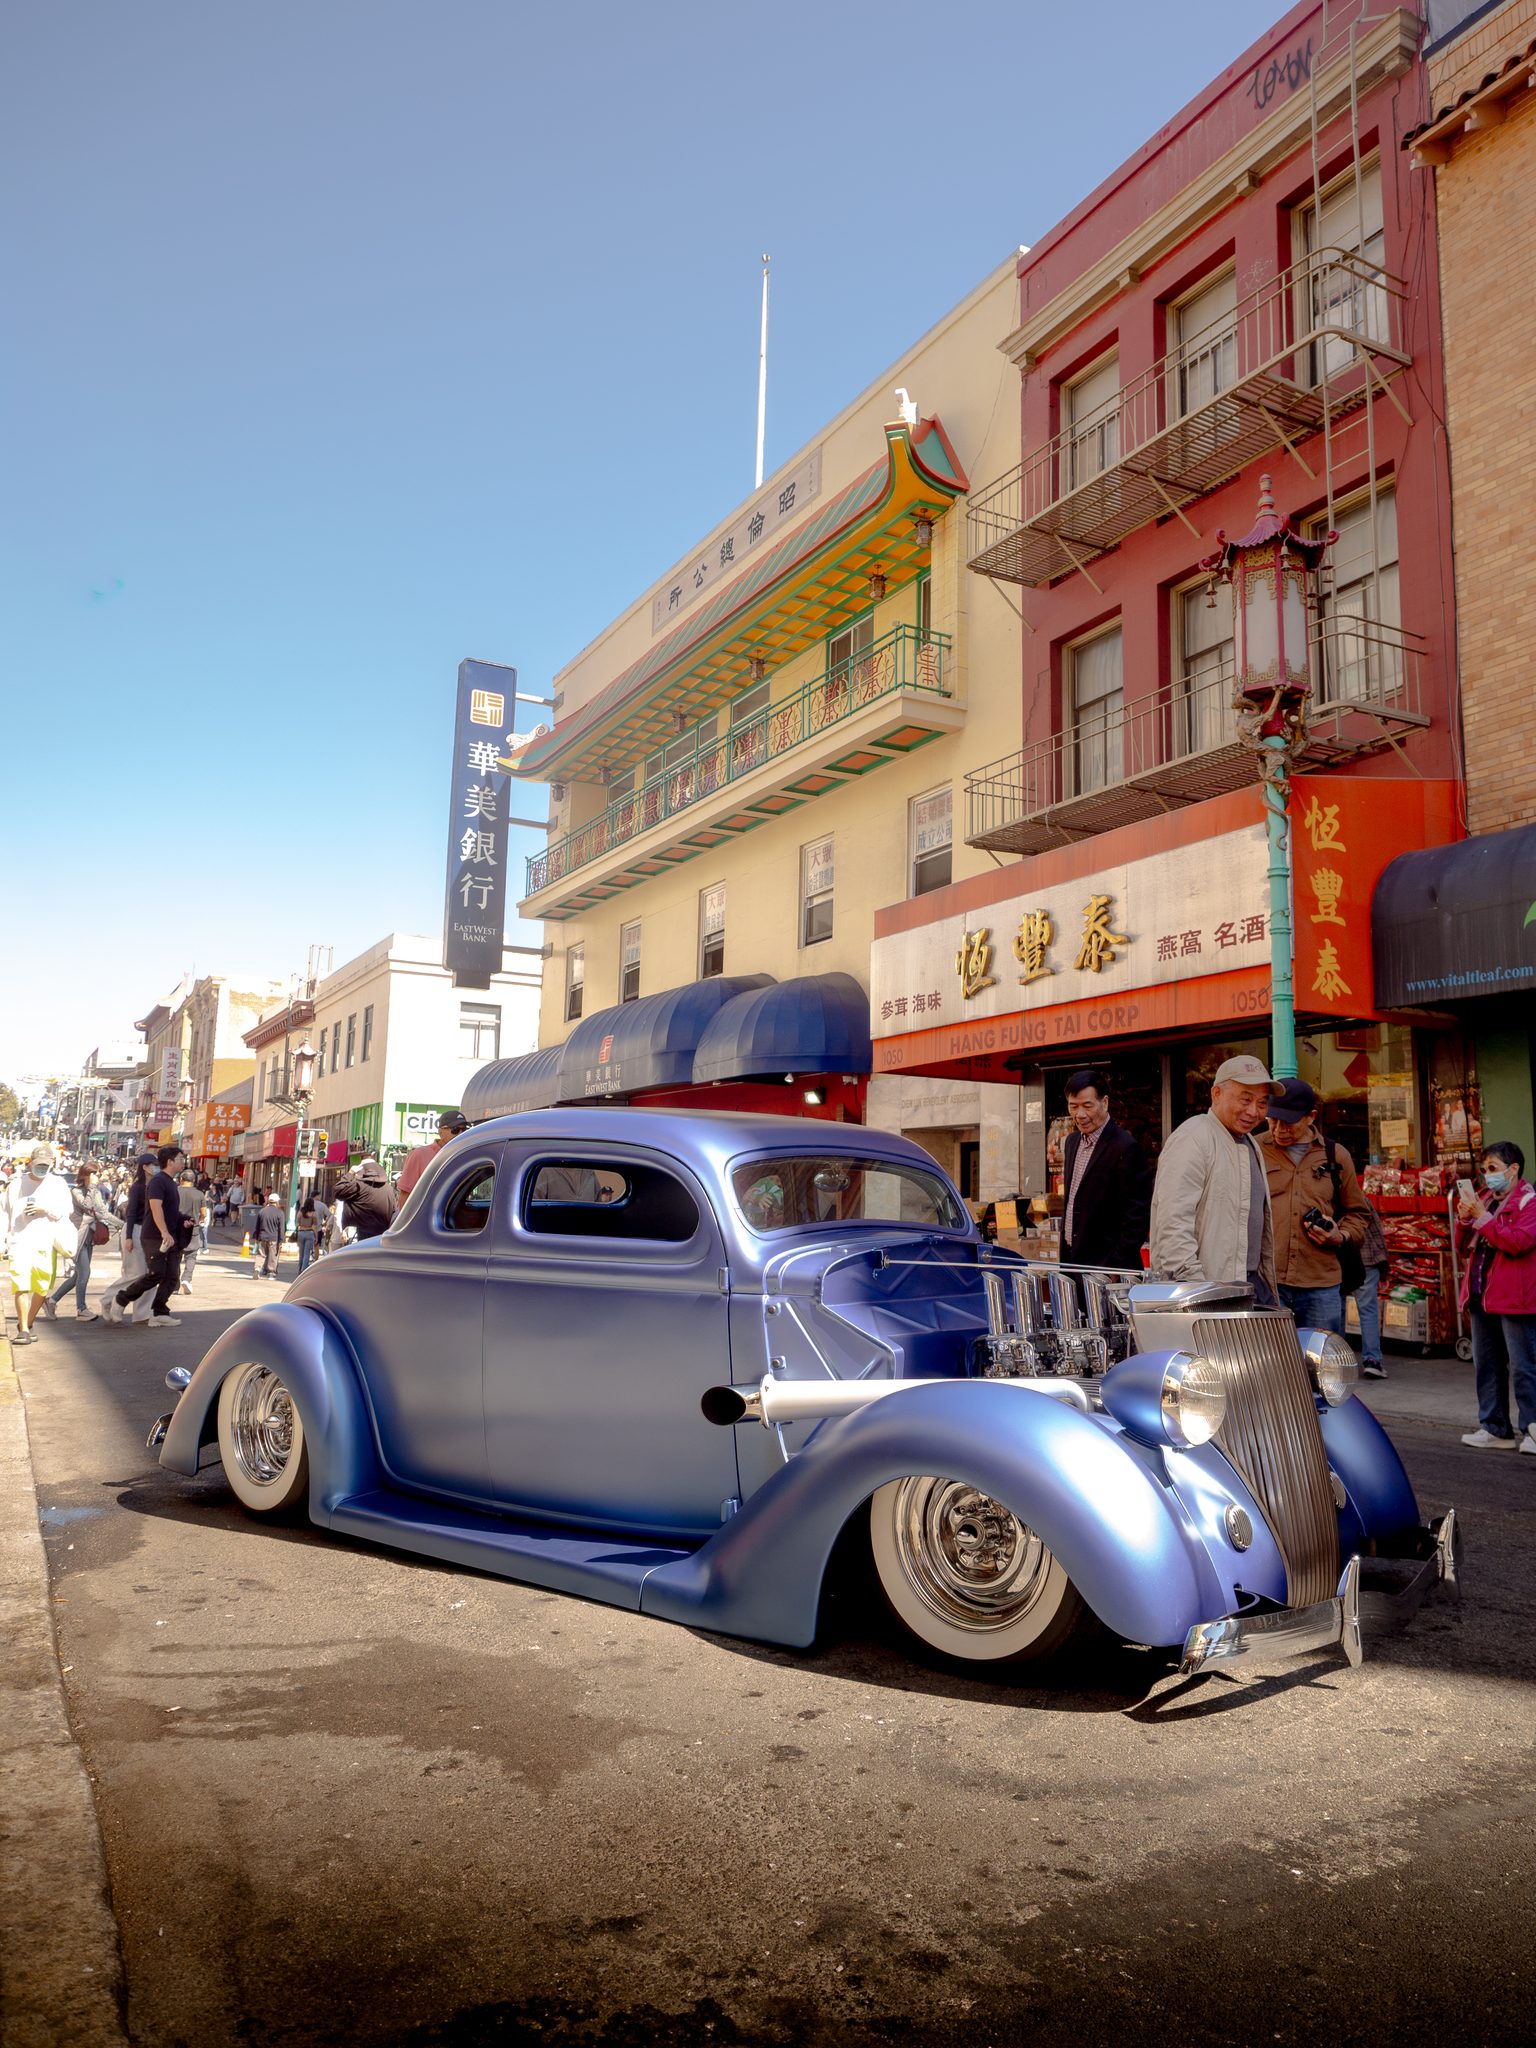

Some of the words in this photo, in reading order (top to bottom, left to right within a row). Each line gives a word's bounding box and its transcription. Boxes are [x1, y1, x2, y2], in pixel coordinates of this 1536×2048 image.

[459, 740, 501, 910] 華美銀行
[453, 922, 497, 936] EASTWEST
[463, 932, 488, 943] BANK
[1157, 929, 1202, 962] 燕窩
[1213, 913, 1265, 949] 名酒
[1406, 965, 1534, 993] www.vitaltleaf.com
[881, 996, 908, 1021] 參茸
[912, 989, 942, 1014] 海味
[1231, 987, 1269, 1013] 1050
[950, 1029, 996, 1056] HANG
[1001, 1021, 1047, 1047] FUNG
[1054, 1013, 1081, 1037] TAI
[1087, 1005, 1139, 1032] CORP
[883, 1048, 904, 1066] 1050
